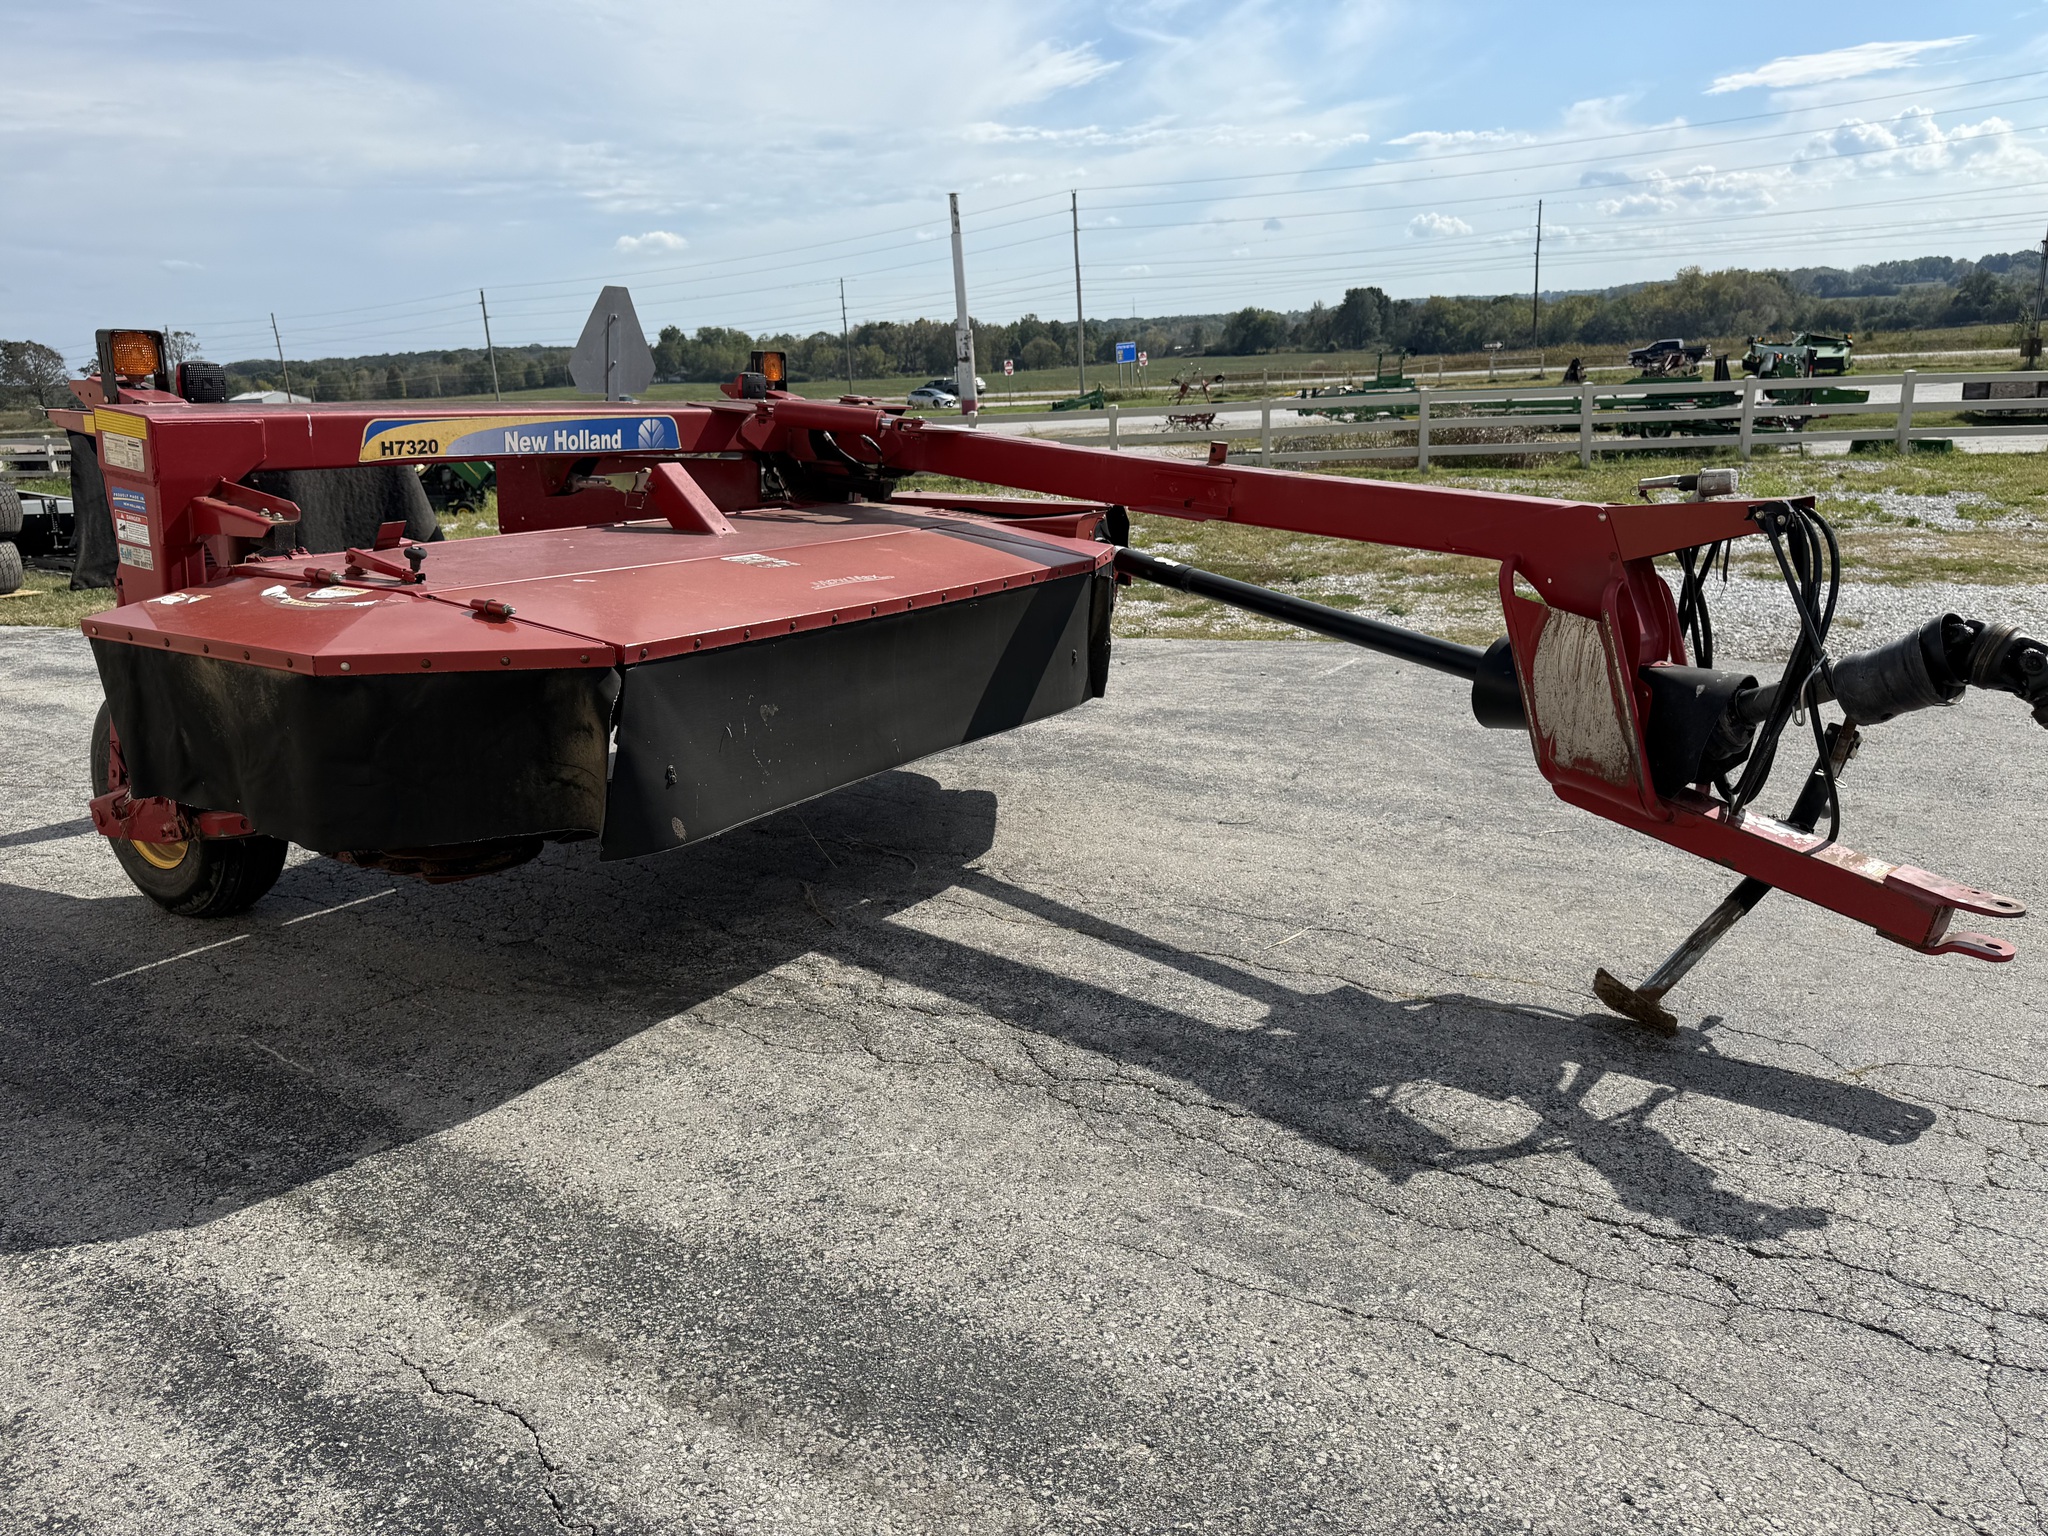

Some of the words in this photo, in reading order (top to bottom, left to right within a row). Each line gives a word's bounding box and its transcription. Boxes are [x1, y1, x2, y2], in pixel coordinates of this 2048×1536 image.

[380, 439, 439, 457] H7320
[504, 430, 548, 453] New
[554, 429, 622, 451] Holland
